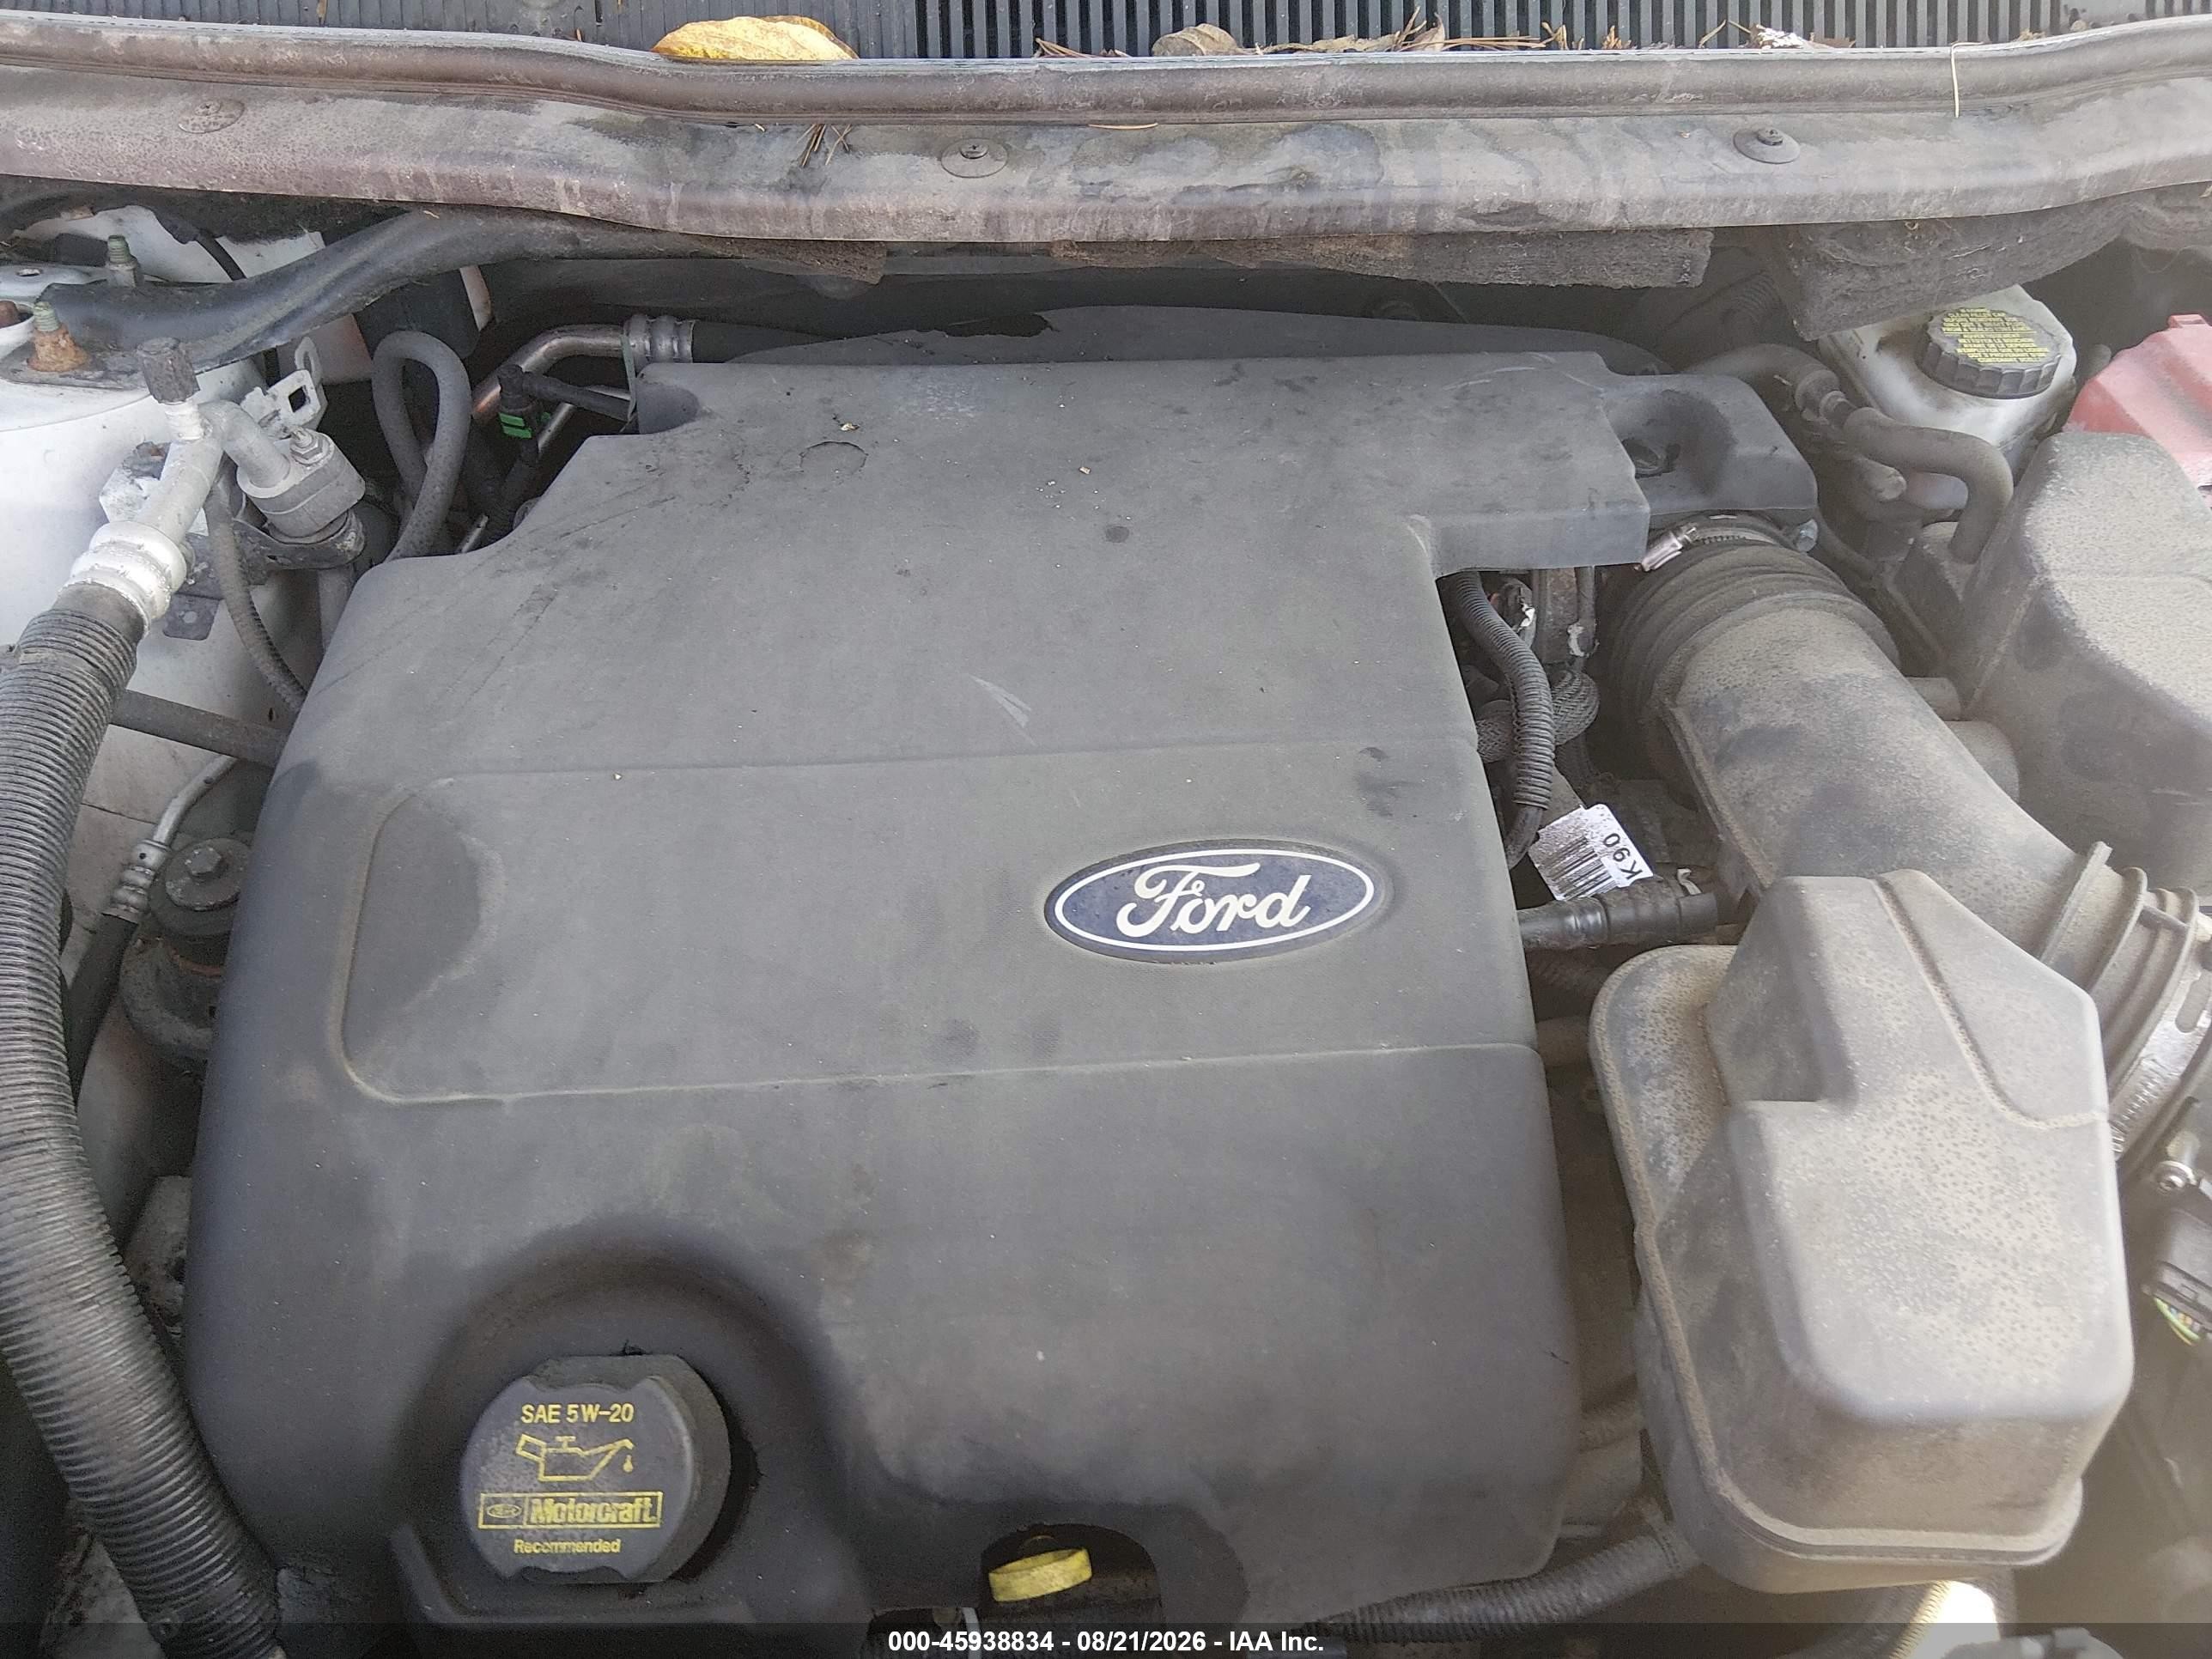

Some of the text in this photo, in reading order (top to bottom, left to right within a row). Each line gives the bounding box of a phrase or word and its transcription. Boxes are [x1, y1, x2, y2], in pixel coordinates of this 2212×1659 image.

[1602, 833, 1644, 880] K90
[1116, 862, 1311, 938] Ford
[520, 1402, 635, 1425] SAE 5W-20
[530, 1498, 656, 1524] Motorcraft
[514, 1539, 622, 1554] Recommended
